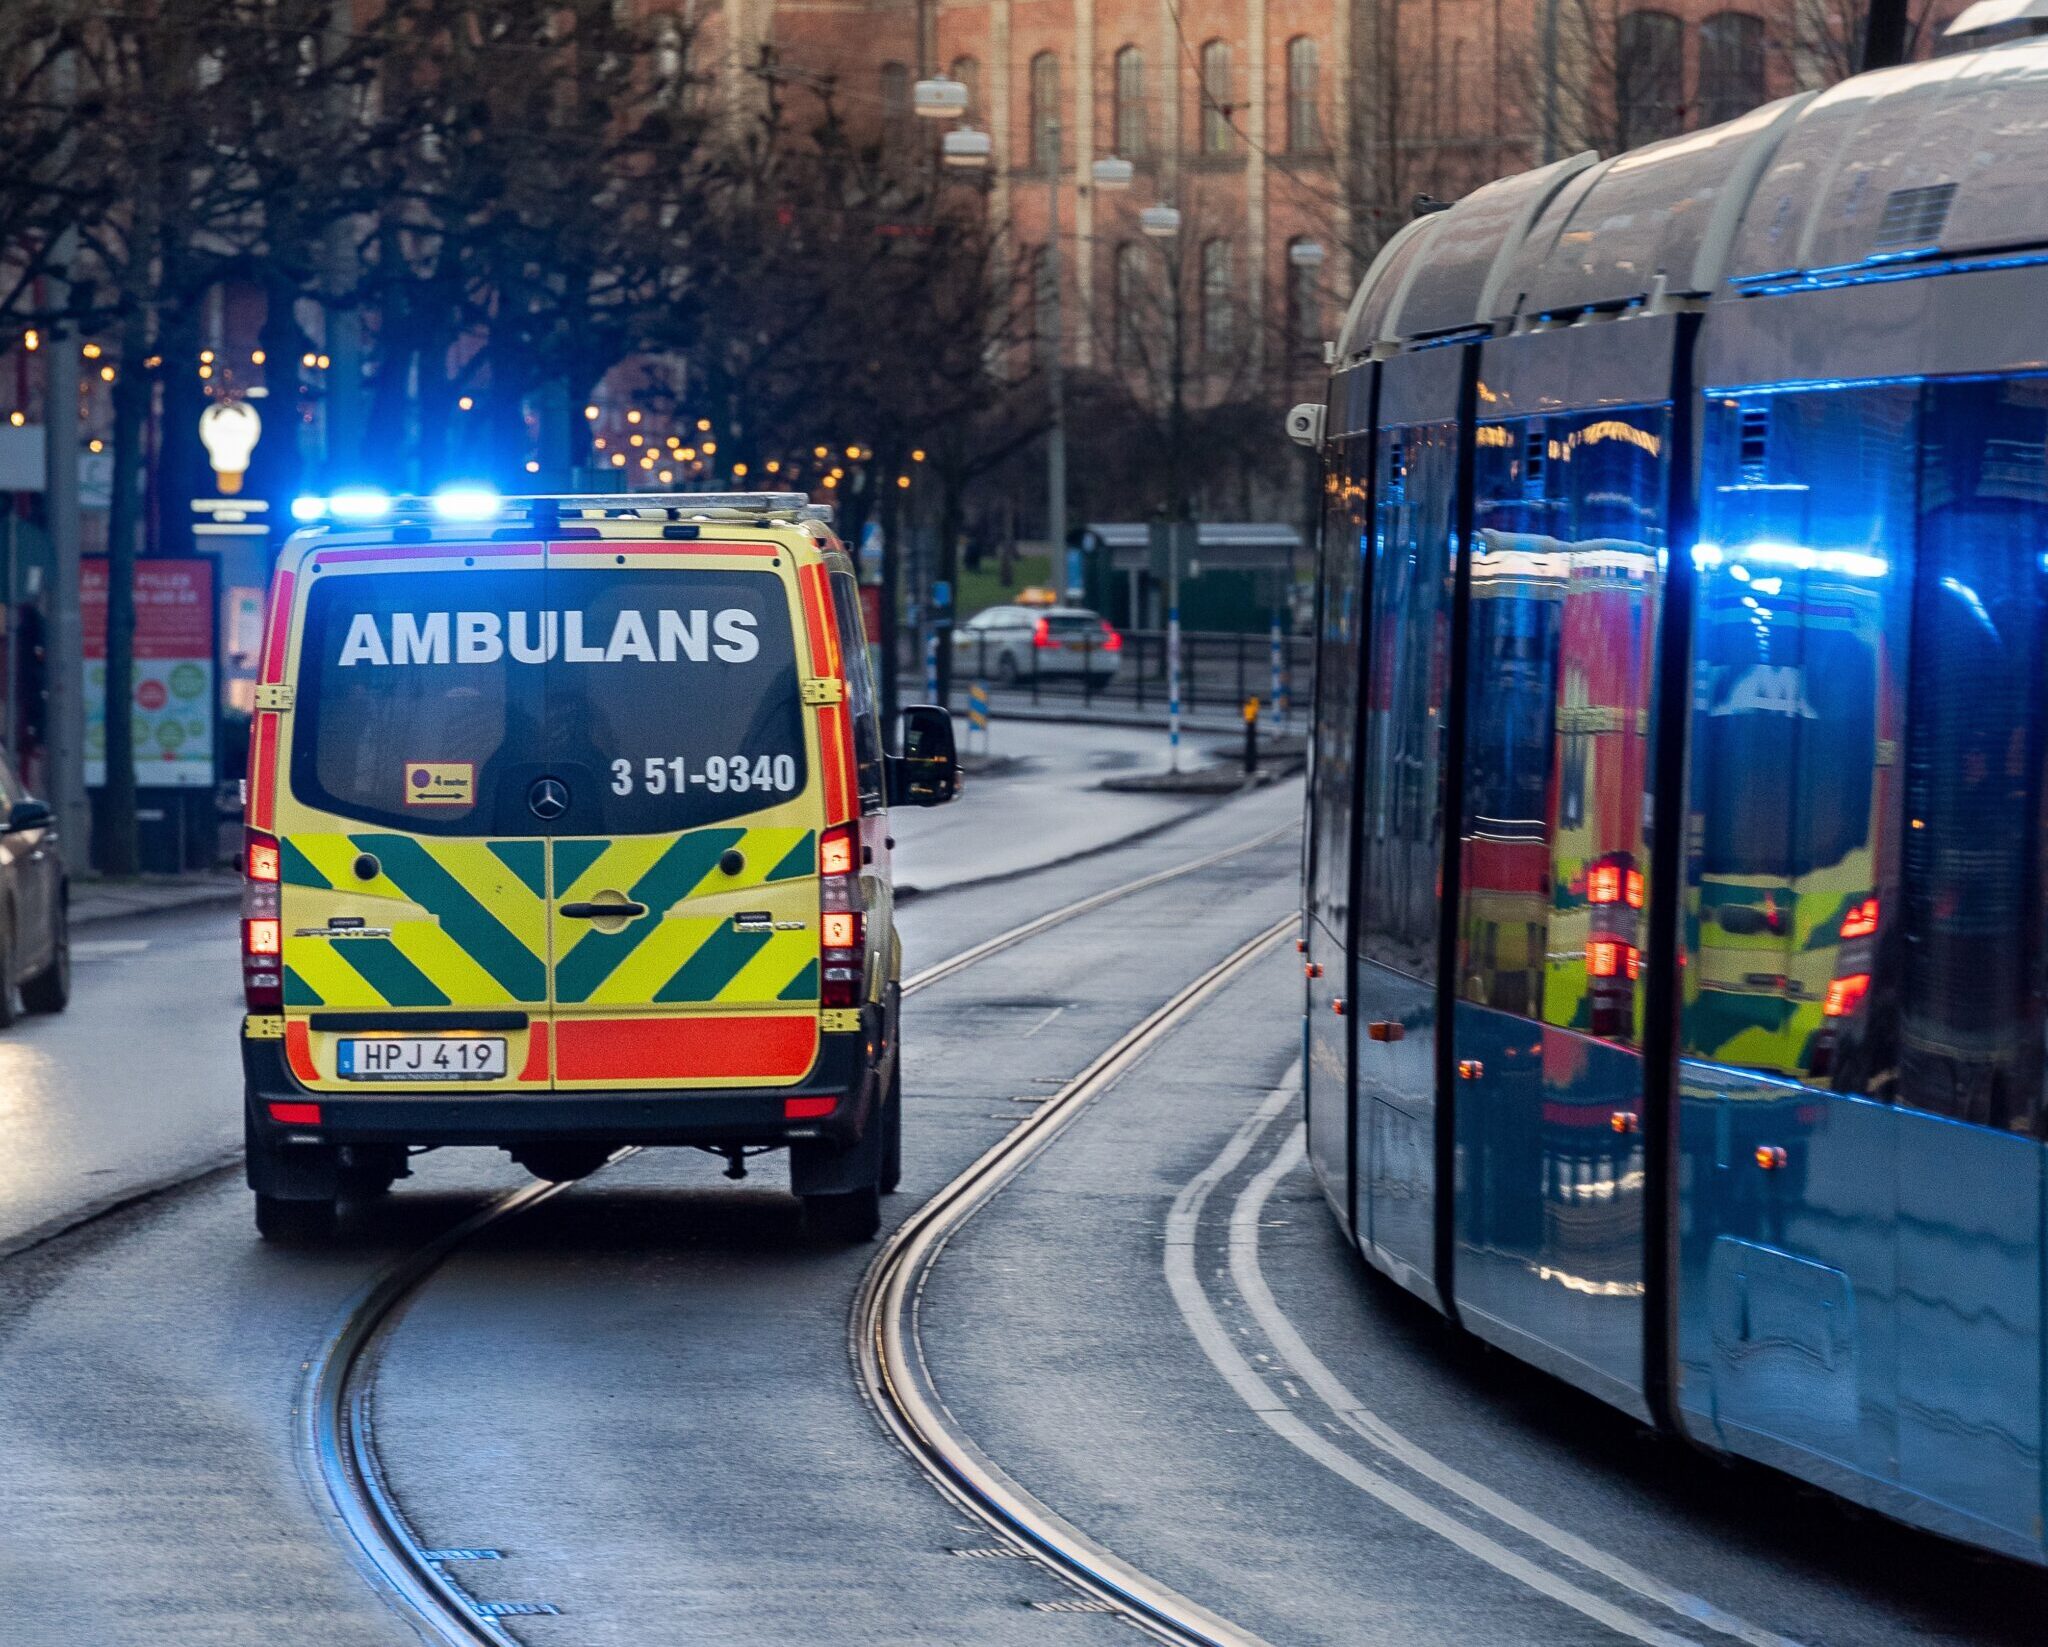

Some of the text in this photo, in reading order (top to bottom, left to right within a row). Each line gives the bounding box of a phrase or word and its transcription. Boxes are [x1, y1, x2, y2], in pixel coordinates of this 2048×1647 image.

[338, 608, 761, 666] AMBULANS
[611, 754, 796, 796] 3 51-9340
[365, 1043, 422, 1070] HPJ
[432, 1043, 492, 1070] 419
